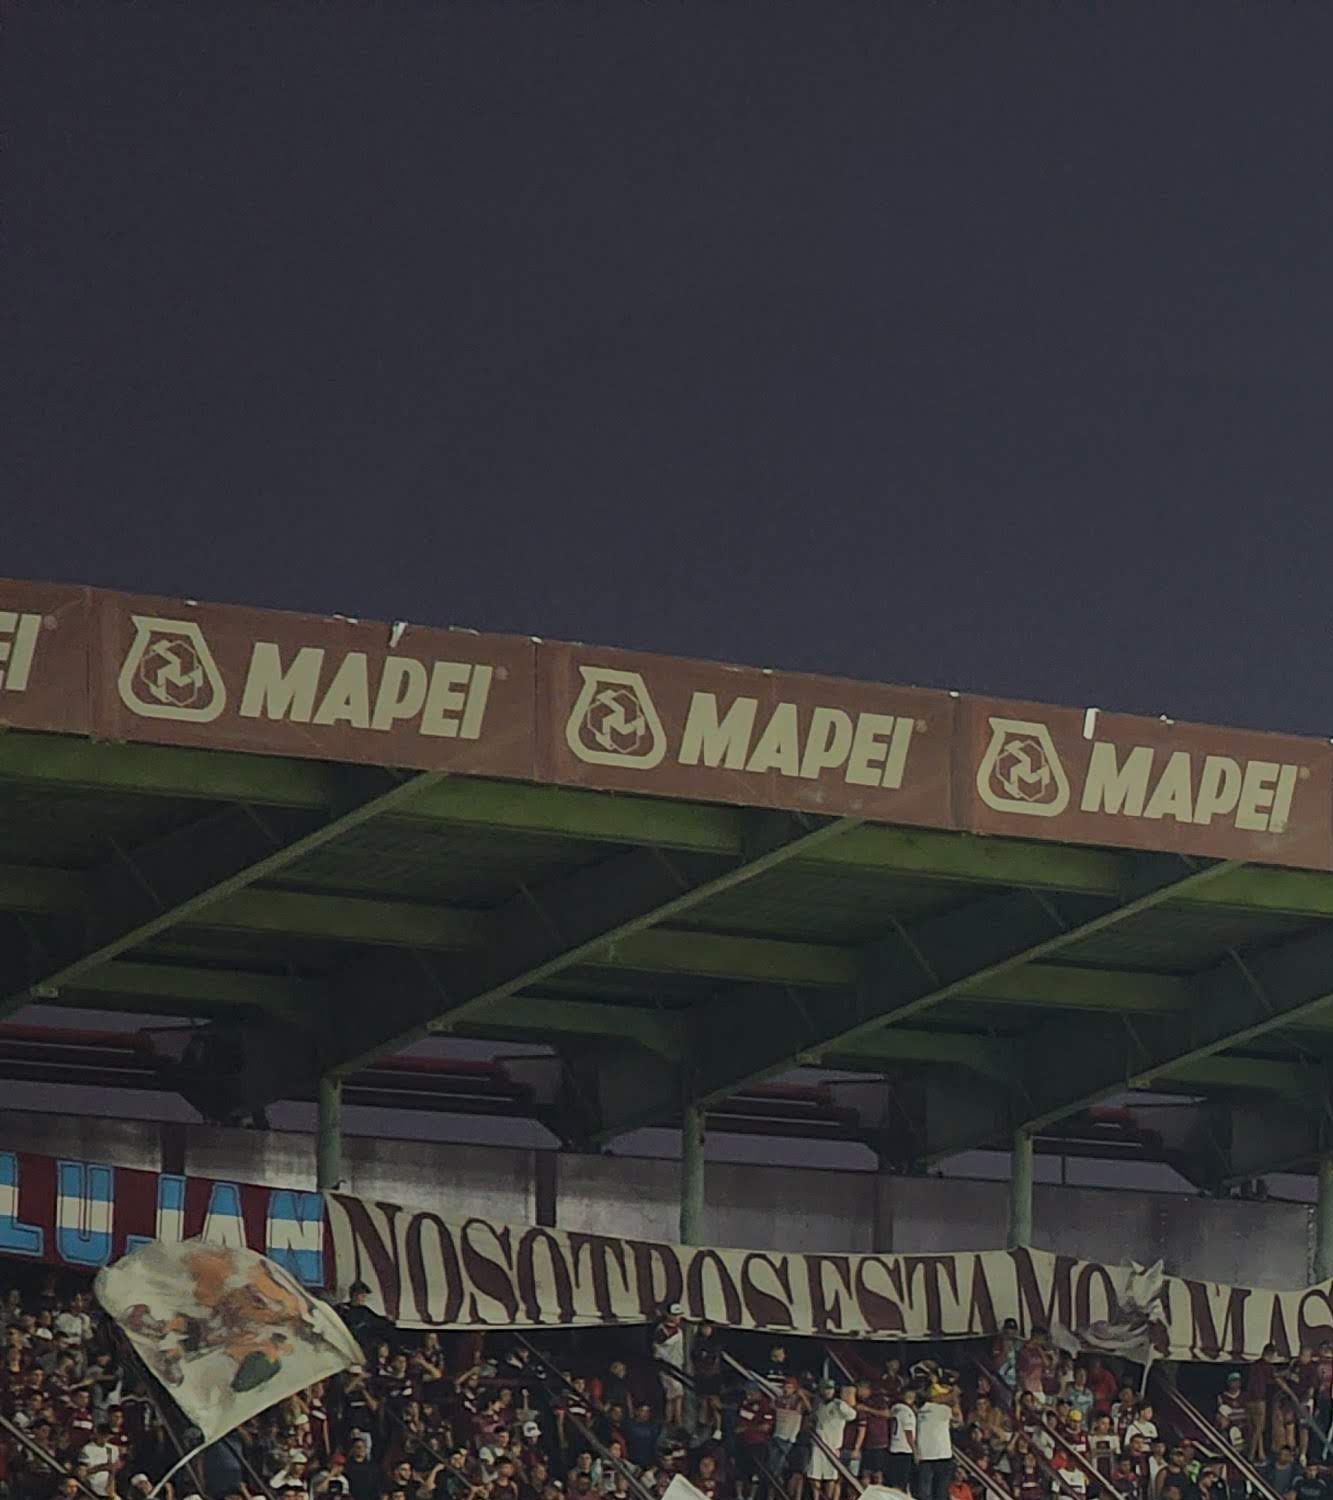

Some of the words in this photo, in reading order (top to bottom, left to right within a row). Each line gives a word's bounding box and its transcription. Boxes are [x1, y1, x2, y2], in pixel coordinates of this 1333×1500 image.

[240, 642, 492, 739] MAPEI
[679, 692, 912, 788] MAPEI
[1082, 742, 1298, 833] MAPEI
[333, 1192, 796, 1331] NOSOTROS
